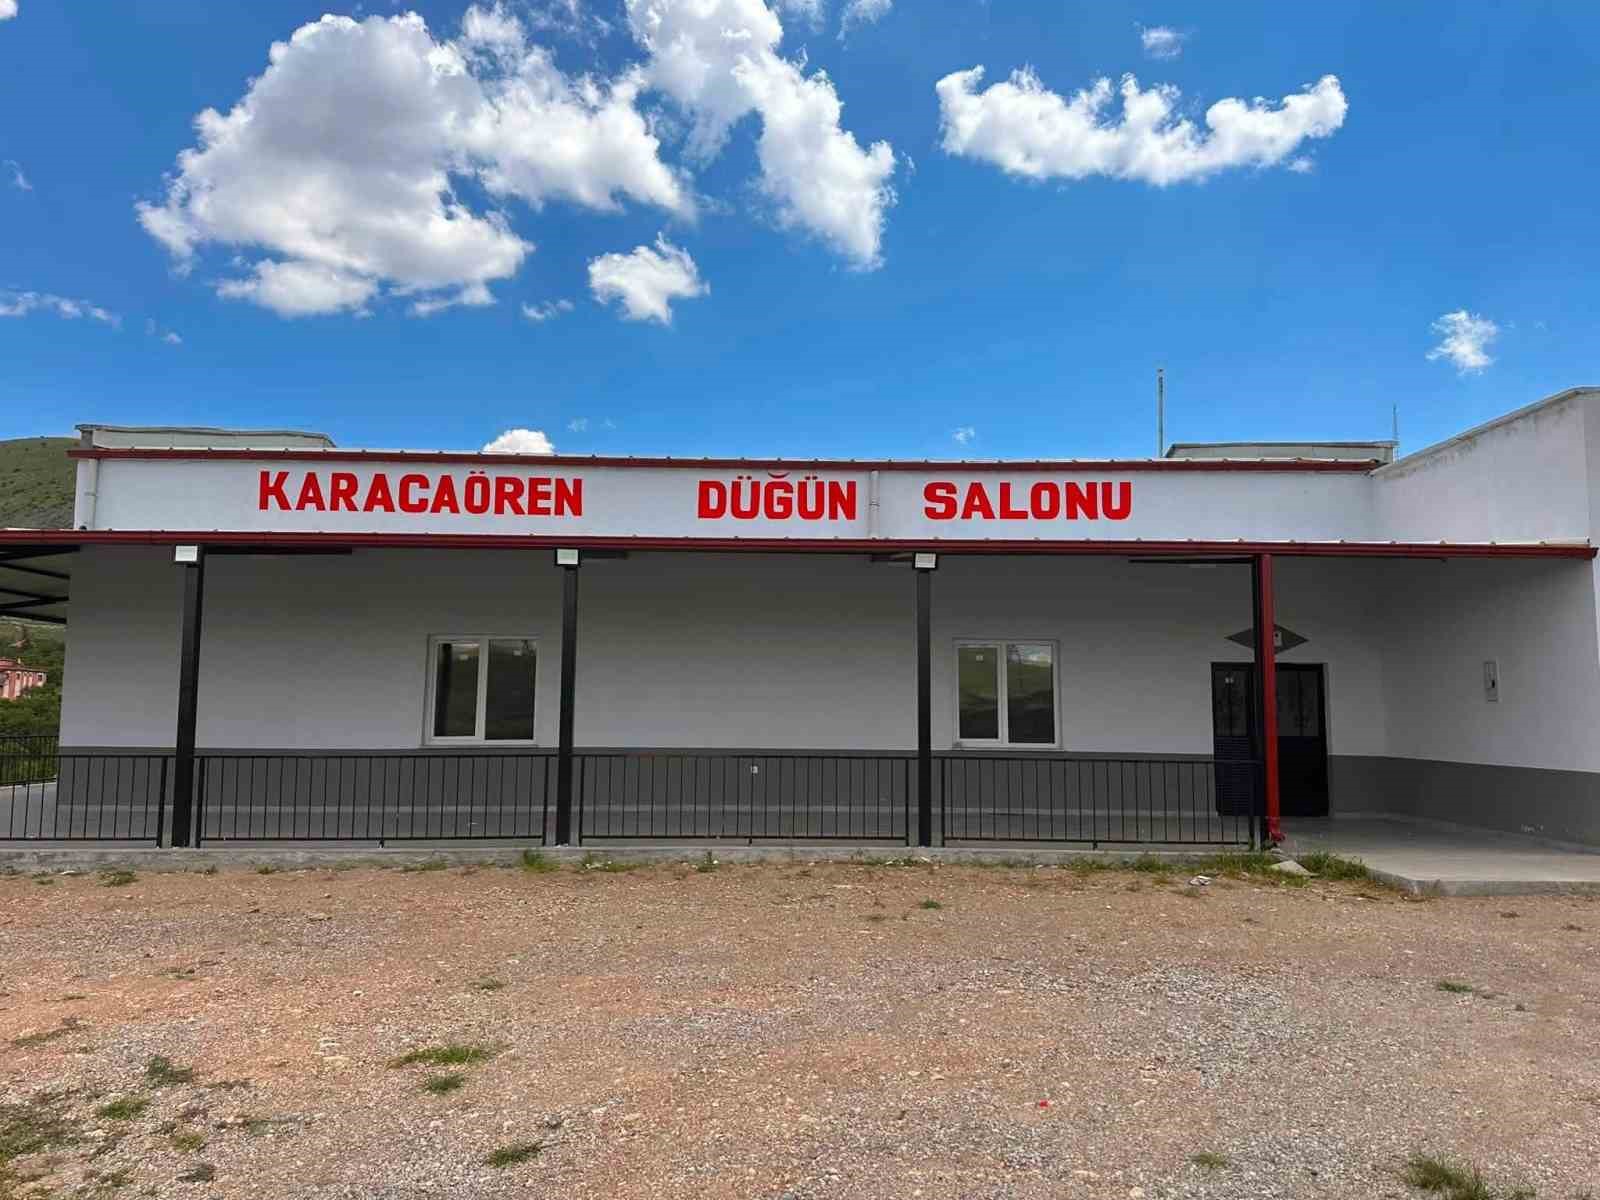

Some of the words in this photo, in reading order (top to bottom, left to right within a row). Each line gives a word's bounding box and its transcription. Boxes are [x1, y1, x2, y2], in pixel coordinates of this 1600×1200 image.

[259, 471, 583, 516] KARACAÖREN
[697, 472, 856, 520] DÜĞÜN
[925, 482, 1133, 520] SALONU
